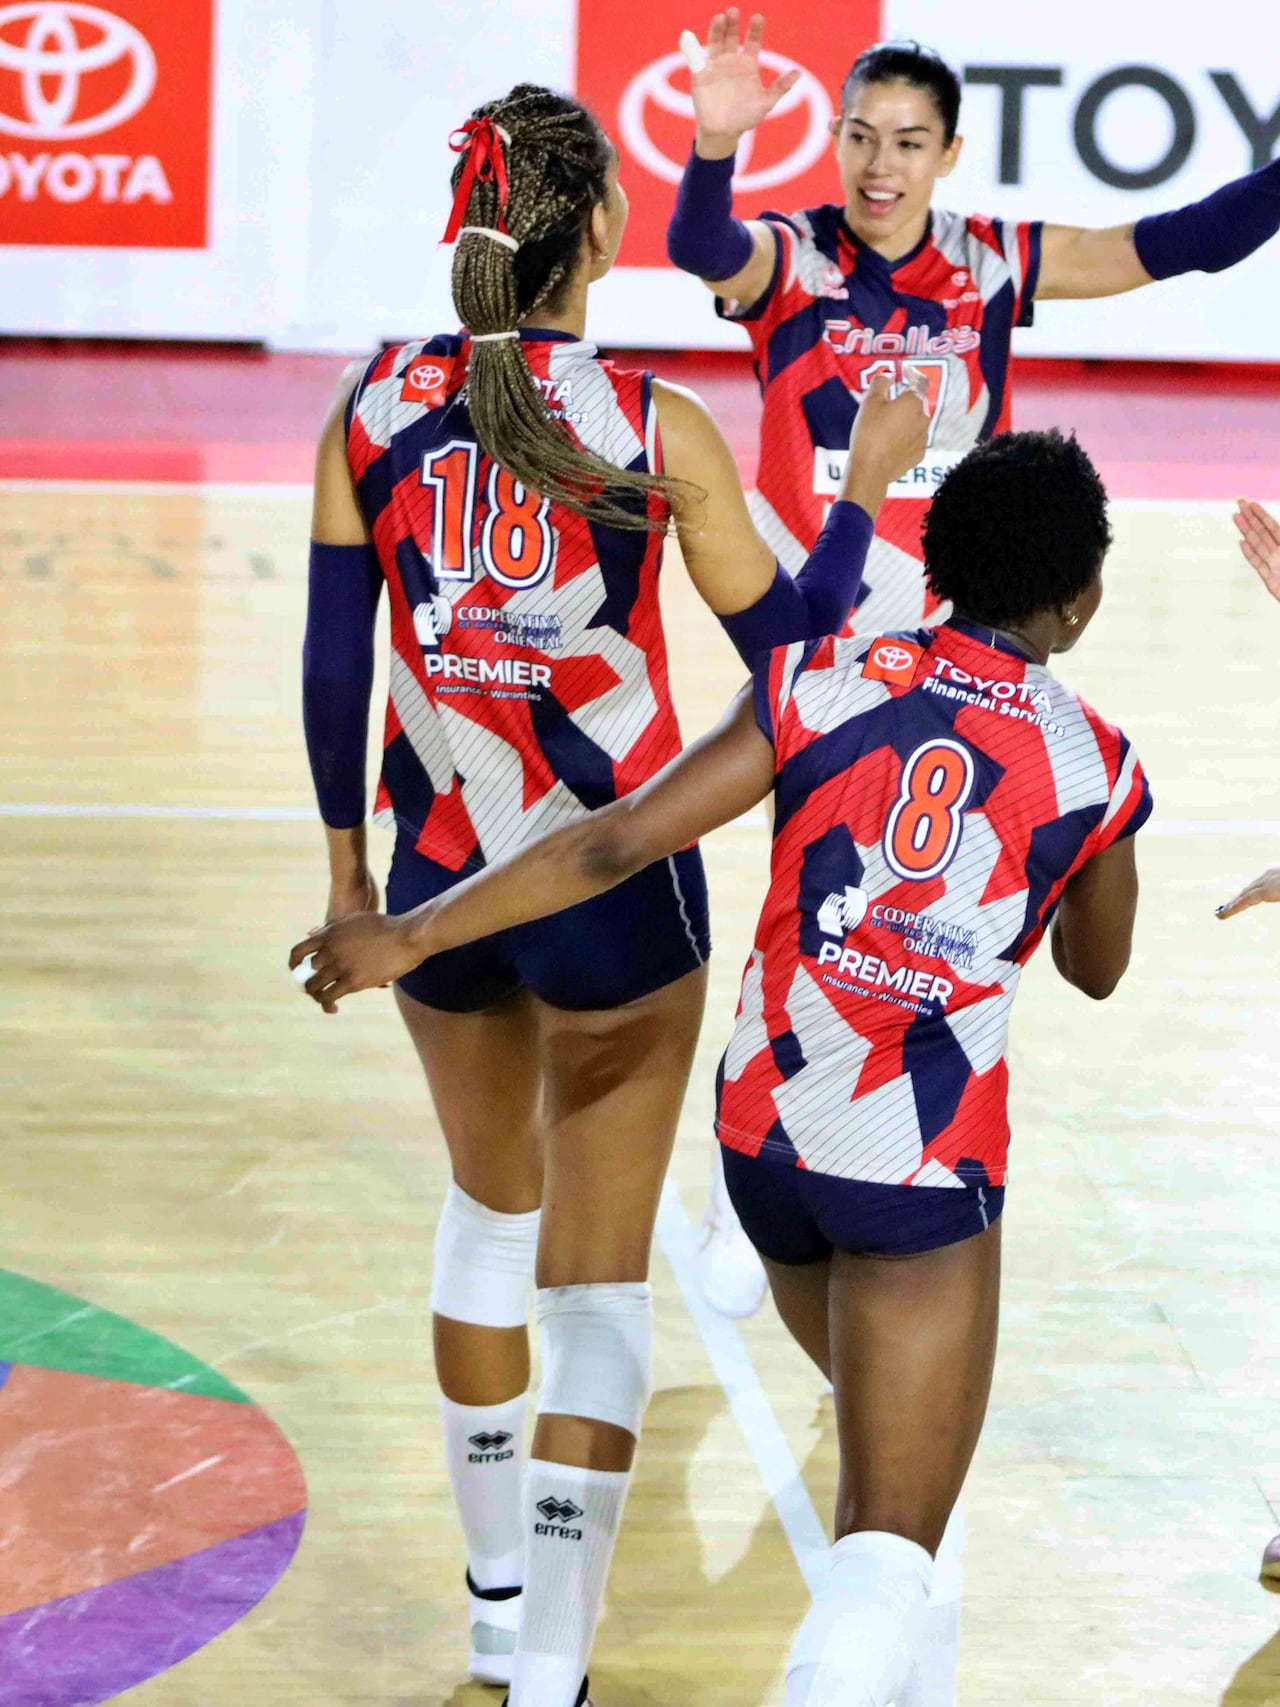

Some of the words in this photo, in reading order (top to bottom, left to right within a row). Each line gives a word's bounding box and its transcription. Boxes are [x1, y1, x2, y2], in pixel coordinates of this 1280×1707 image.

[0, 152, 174, 204] YOTA
[422, 438, 552, 590] 18
[457, 606, 562, 629] COOPERATIVA
[424, 653, 552, 688] PREMIER
[934, 656, 1054, 714] TOYOTA
[921, 677, 996, 711] Financial
[999, 702, 1066, 737] Services
[883, 737, 975, 880] 8
[871, 904, 979, 948] COOPERATIVA
[817, 940, 954, 1006] PREMIER
[903, 936, 973, 971] ORIENTAL
[822, 973, 870, 998] Insurance
[877, 992, 933, 1016] Warranties
[468, 1449, 514, 1463] errea
[534, 1522, 582, 1540] errea
